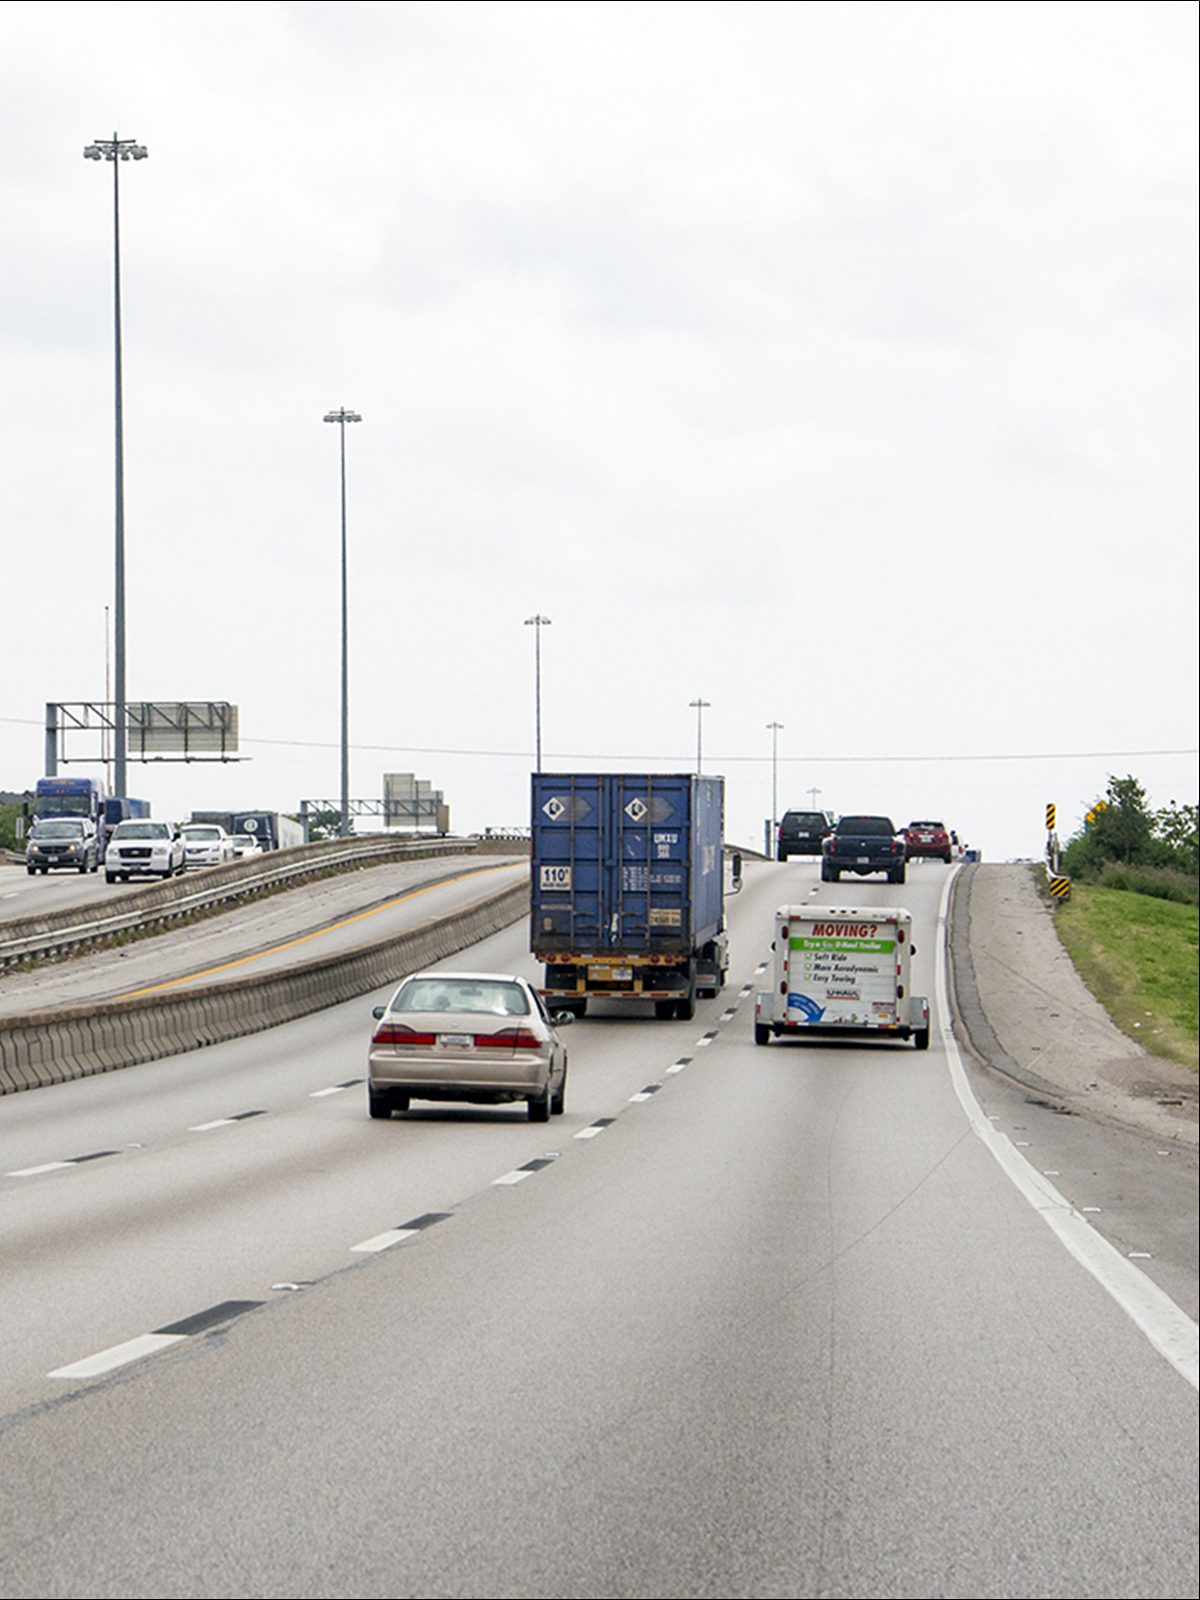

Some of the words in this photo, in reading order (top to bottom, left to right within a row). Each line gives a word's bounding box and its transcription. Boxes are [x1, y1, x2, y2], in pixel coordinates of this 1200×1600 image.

[812, 924, 878, 938] MOVING?
[804, 940, 815, 949] Try
[814, 952, 830, 961] Soft
[831, 953, 848, 961] Ride
[813, 963, 832, 972] More
[833, 964, 879, 973] Aerodynamic
[813, 973, 829, 983] Easy
[831, 974, 856, 985] Towing
